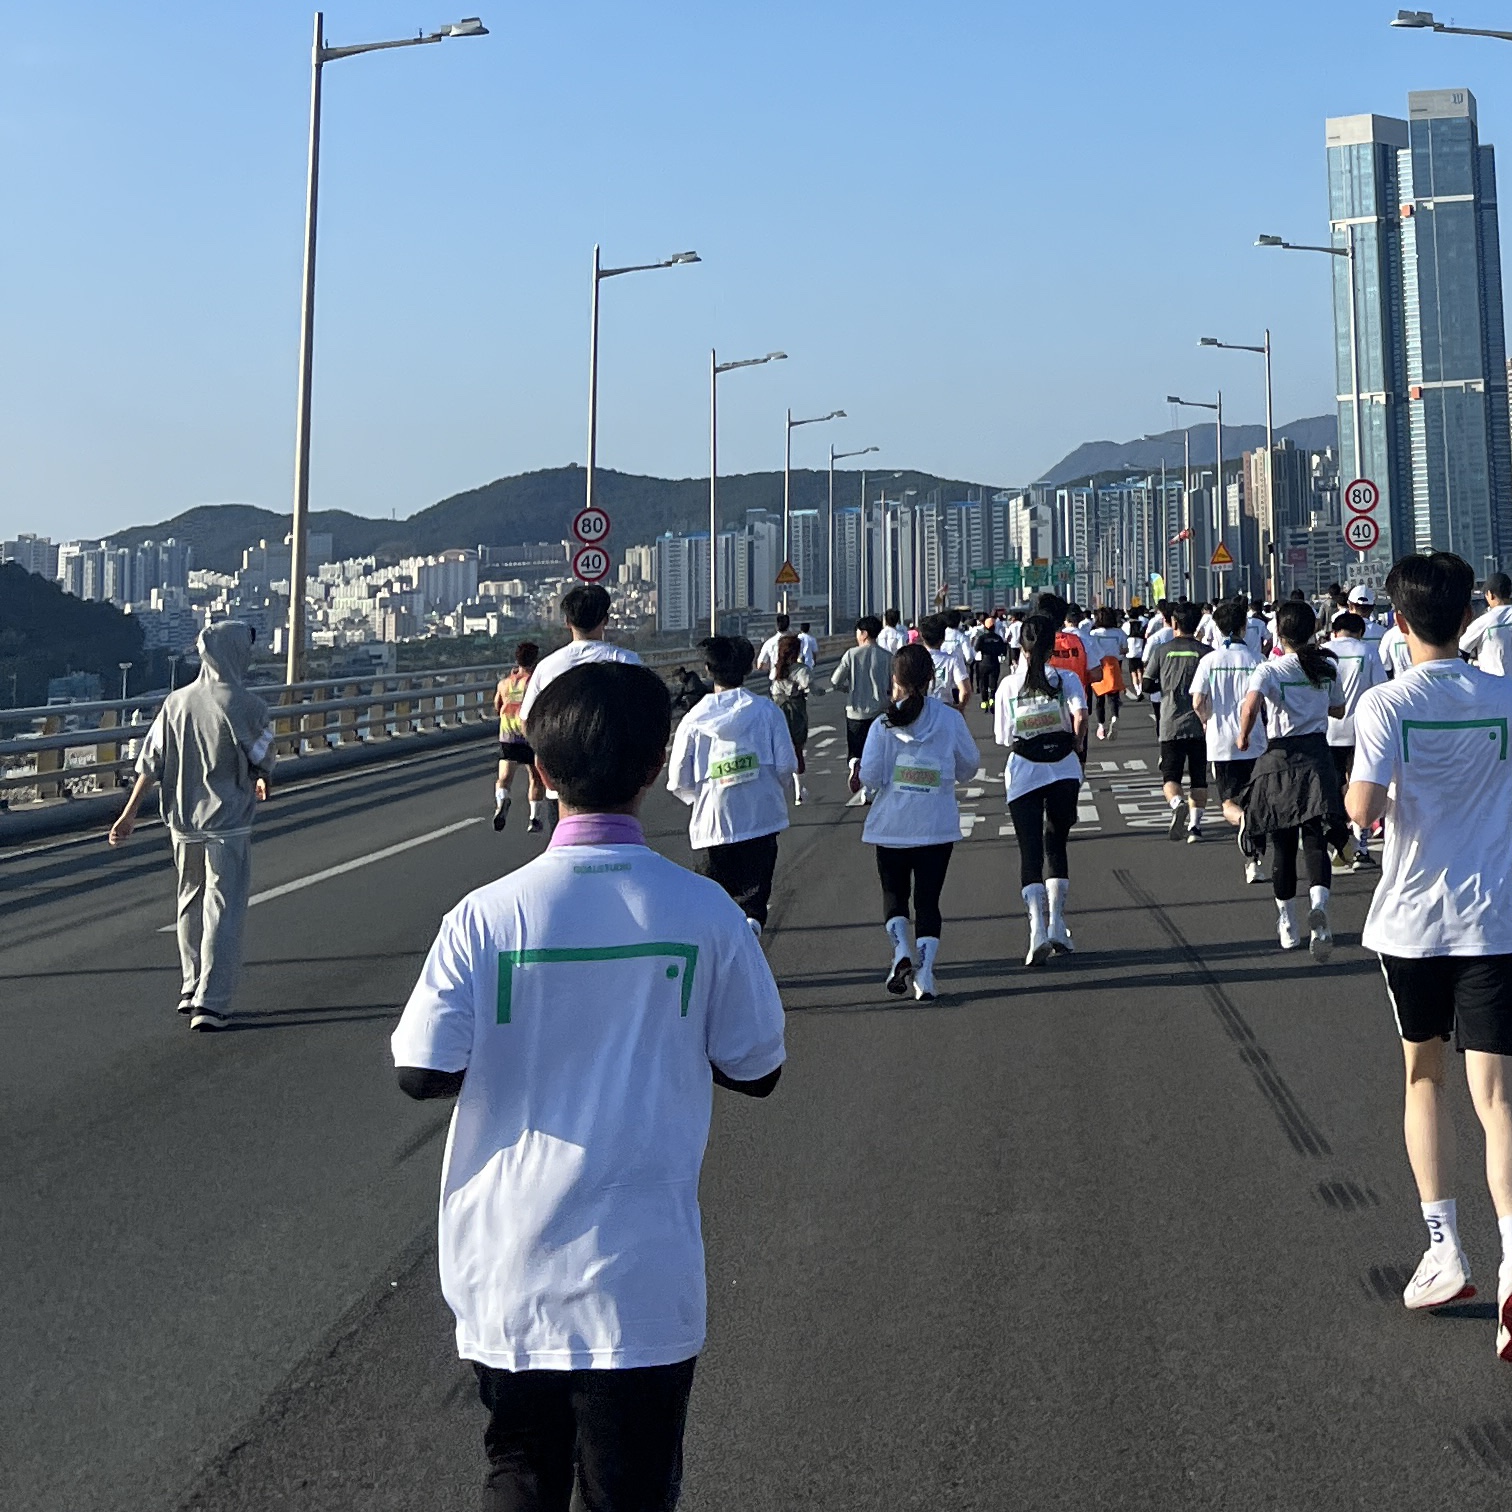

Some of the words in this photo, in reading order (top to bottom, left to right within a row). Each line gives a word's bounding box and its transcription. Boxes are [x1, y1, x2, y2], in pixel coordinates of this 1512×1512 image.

[1352, 488, 1372, 504] 80
[582, 517, 603, 534] 80
[1352, 524, 1371, 539] 40
[581, 554, 602, 569] 40
